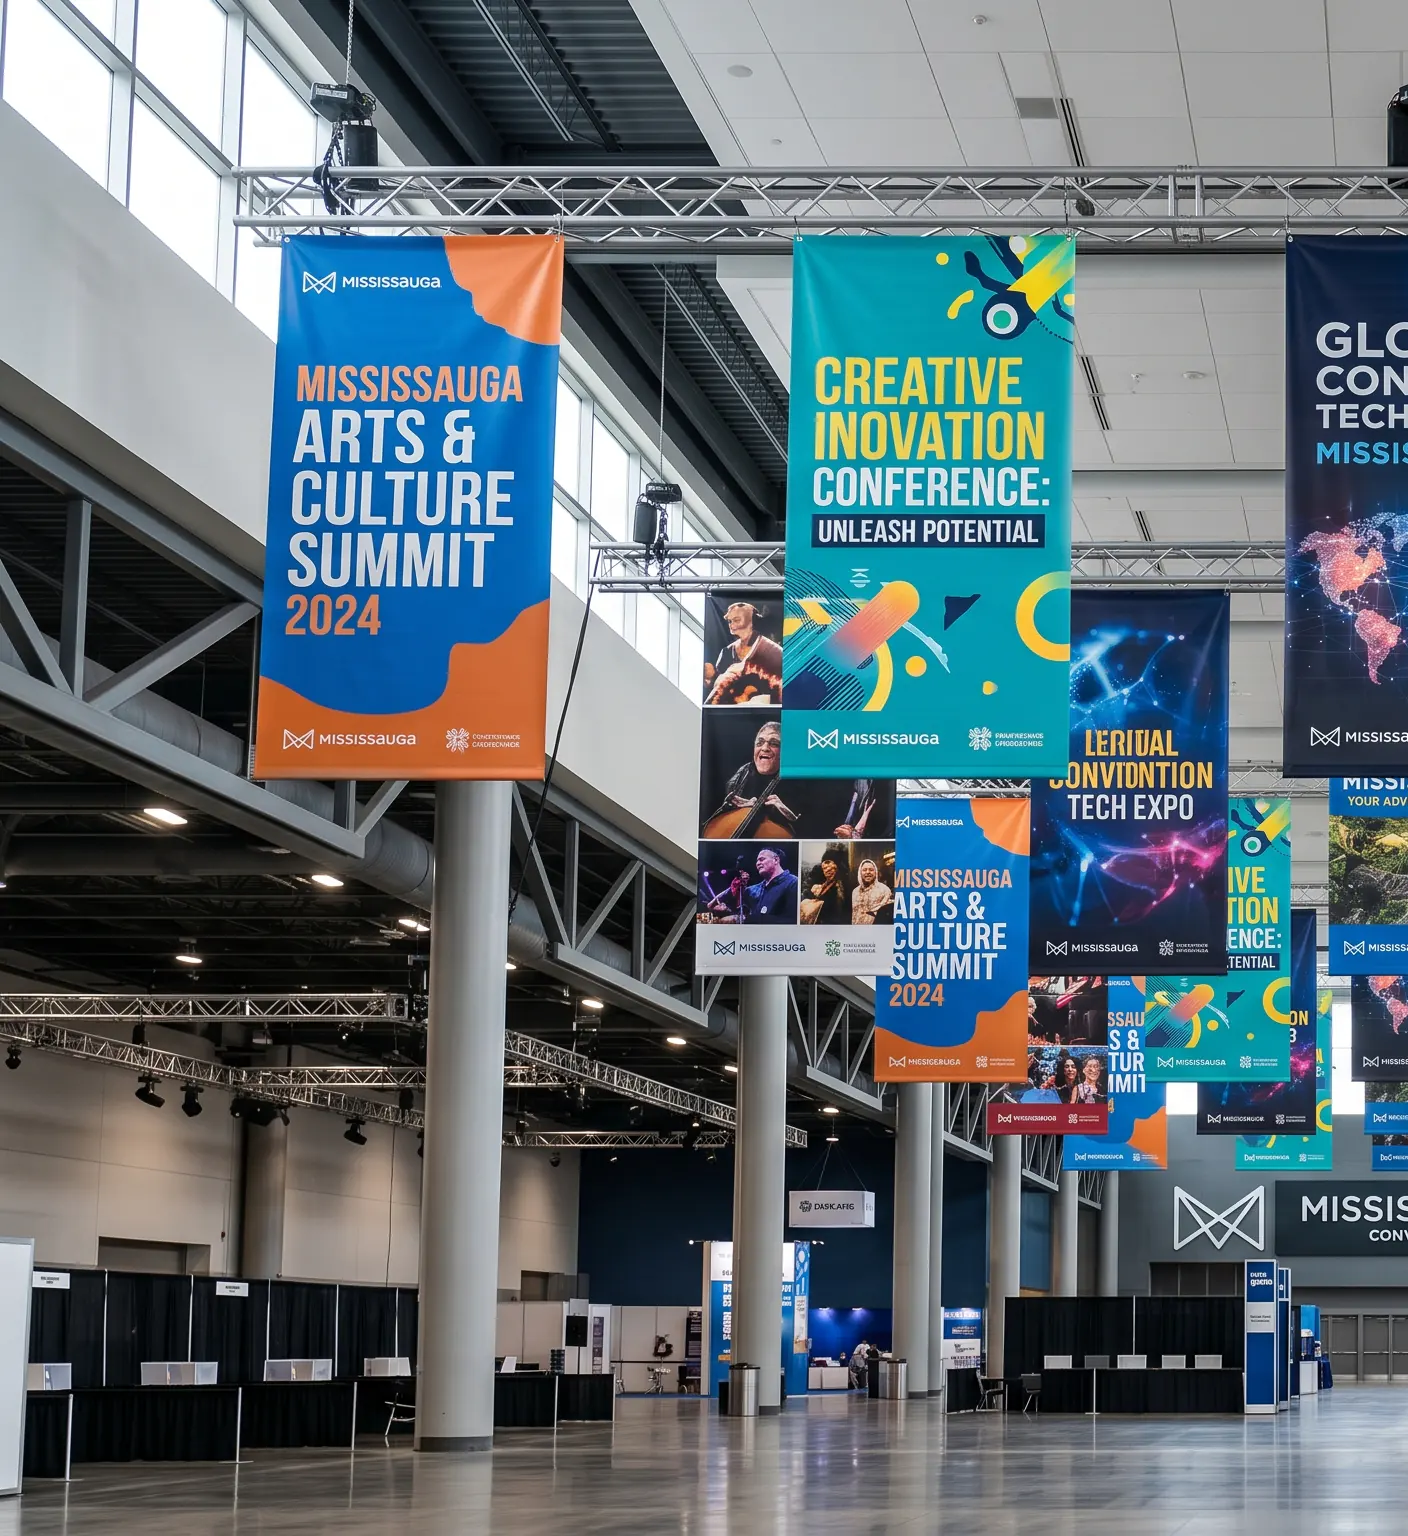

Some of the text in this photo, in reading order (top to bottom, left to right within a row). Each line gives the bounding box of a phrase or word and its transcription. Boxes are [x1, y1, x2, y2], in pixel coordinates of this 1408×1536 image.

[297, 365, 523, 402] MISSISSAUGA
[815, 356, 1022, 405] CREATIVE
[293, 408, 476, 464] ARTS &
[814, 411, 1045, 460] INOVATION
[291, 470, 515, 526] CULTURE
[813, 467, 1050, 507] CONFERENCE:
[818, 519, 1038, 543] UNLEASH POTENTIAL
[288, 532, 495, 588] SUMMIT
[285, 594, 381, 636] 2024
[1068, 794, 1193, 820] TECH EXPO
[1348, 796, 1379, 806] YOUR
[894, 869, 1012, 888] MISSISSAUGA
[893, 891, 985, 920] ARTS &
[893, 922, 1007, 950] CULTURE
[891, 952, 998, 980] SUMMIT
[1227, 955, 1275, 968] TENTIAL
[889, 982, 944, 1007] 2024
[1127, 1029, 1140, 1051] &
